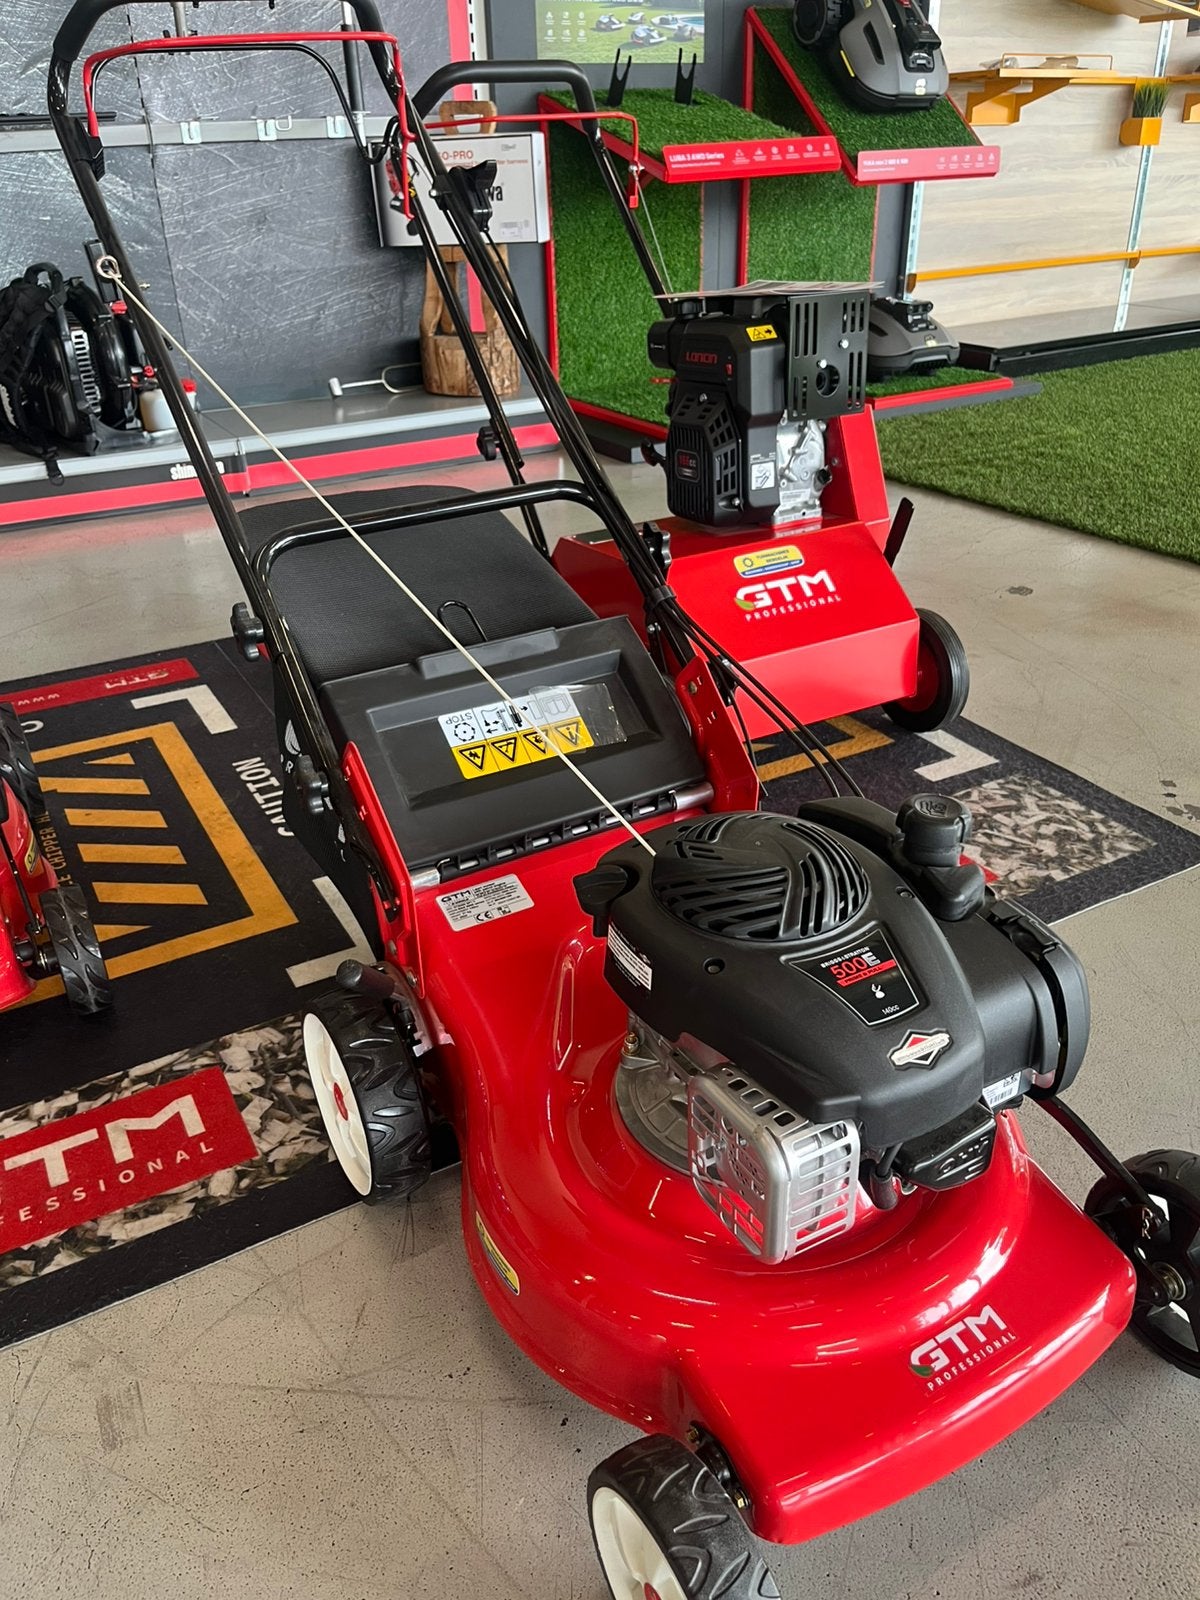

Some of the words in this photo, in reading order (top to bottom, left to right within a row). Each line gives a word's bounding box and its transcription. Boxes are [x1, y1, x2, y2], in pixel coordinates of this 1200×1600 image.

[735, 569, 837, 610] GTM
[744, 593, 842, 623] PROFESSIONAL
[445, 711, 473, 725] STOP
[39, 826, 67, 871] CHIPPER
[441, 889, 472, 903] GTM
[830, 951, 881, 979] 500E
[881, 1004, 900, 1016] 140cc
[0, 1094, 207, 1189] TM
[0, 1142, 214, 1225] ESSIONAL
[909, 1304, 1008, 1376] GTM
[926, 1332, 1017, 1392] PROFESSIONAL
